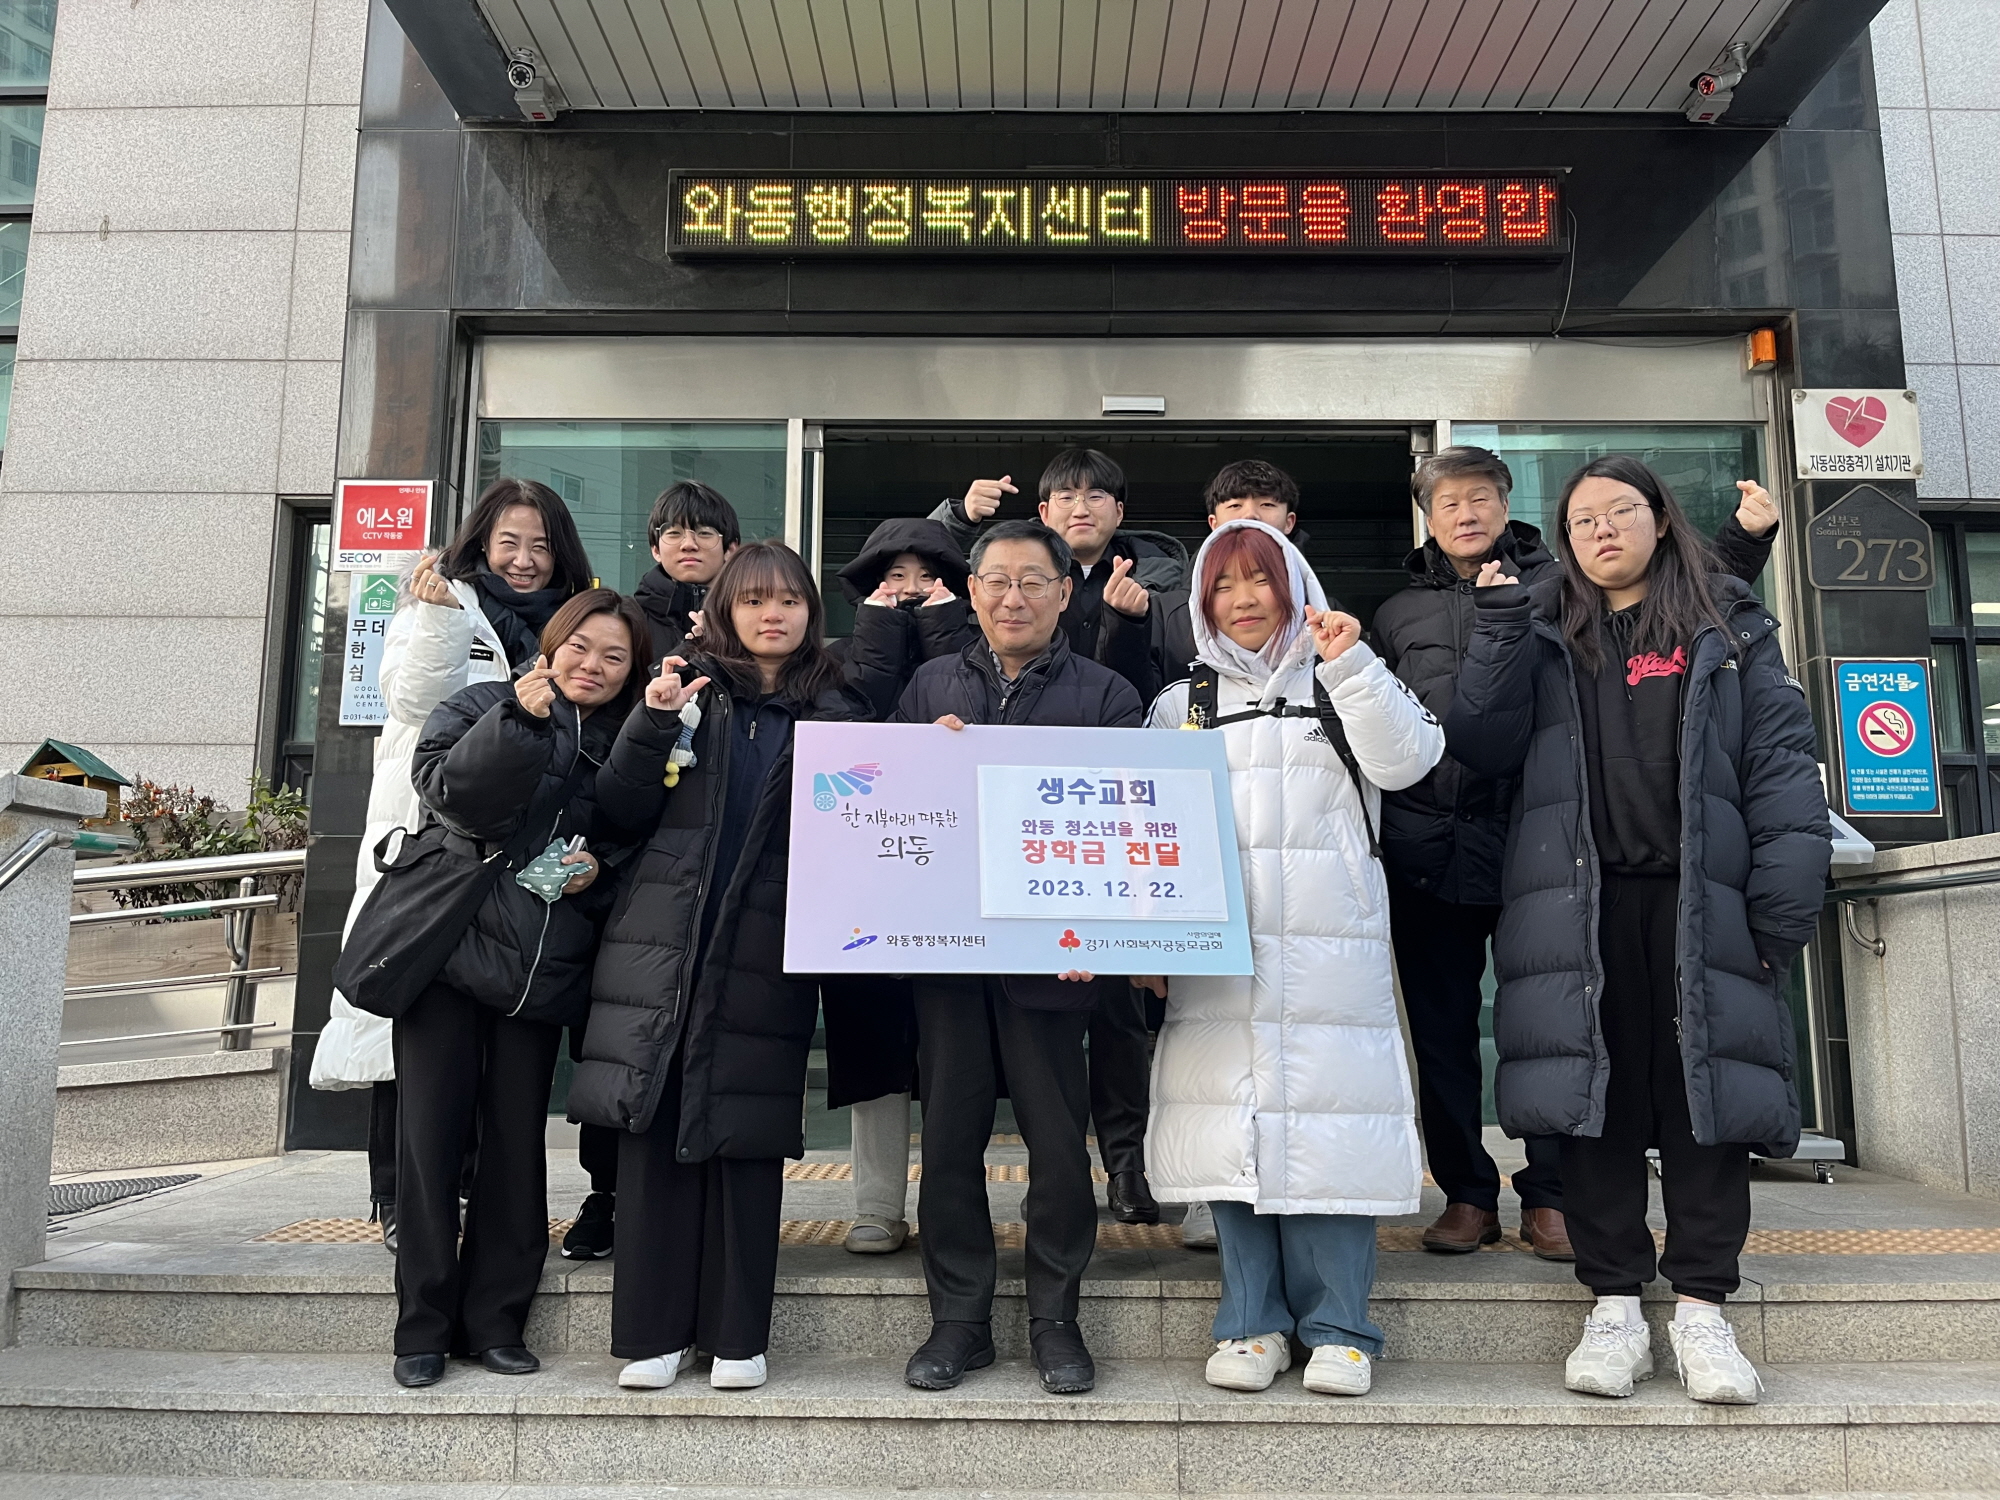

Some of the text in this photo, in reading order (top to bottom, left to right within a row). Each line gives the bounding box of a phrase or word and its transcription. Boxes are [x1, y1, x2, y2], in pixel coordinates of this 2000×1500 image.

[682, 184, 1556, 242] 와동행정복지센터 방문을 환영합
[1809, 454, 1911, 472] 자동심장충격기 설치기관
[356, 507, 414, 529] 에스원
[1826, 515, 1861, 527] 선부로
[362, 531, 404, 540] CCTV 작동중
[339, 552, 382, 563] SECOM
[1836, 538, 1928, 582] 273
[351, 619, 386, 637] 무더
[350, 641, 367, 659] 한
[348, 664, 364, 682] 쉼
[1844, 672, 1912, 693] 금연건물
[1036, 777, 1156, 807] 생수교회
[841, 802, 958, 829] 한 지붕아래 따뜻한
[1021, 819, 1178, 838] 와동 청소년을 위한
[877, 835, 935, 866] 와동
[1021, 839, 1181, 867] 장학금 전달
[1027, 879, 1183, 898] 2023. 12. 22.
[886, 934, 986, 947] 와동행정복지센터
[1084, 939, 1223, 953] 경기 사회복지공동모금회
